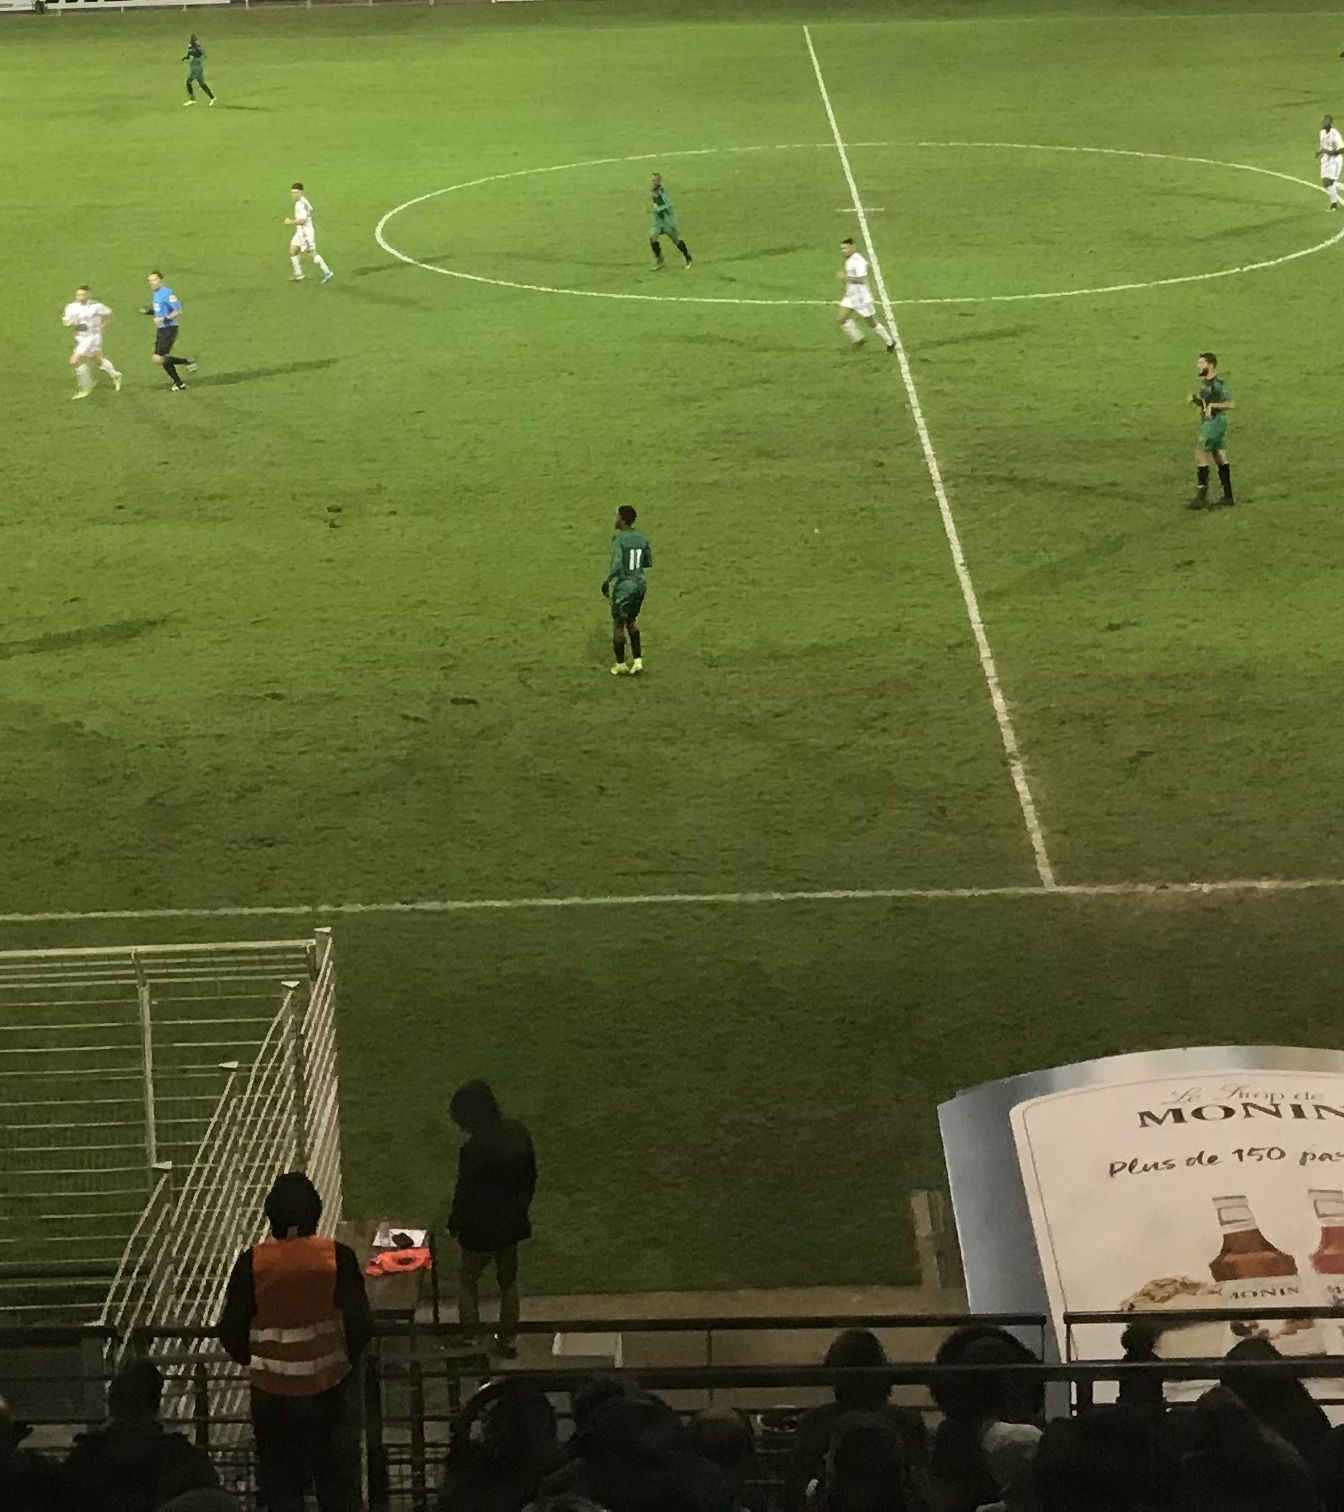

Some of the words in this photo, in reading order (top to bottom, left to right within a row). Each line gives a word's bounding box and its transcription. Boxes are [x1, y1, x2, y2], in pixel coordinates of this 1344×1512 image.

[629, 548, 643, 571] 11
[1108, 1157, 1177, 1178] Plus
[1185, 1150, 1223, 1166] de
[1232, 1146, 1286, 1162] 150
